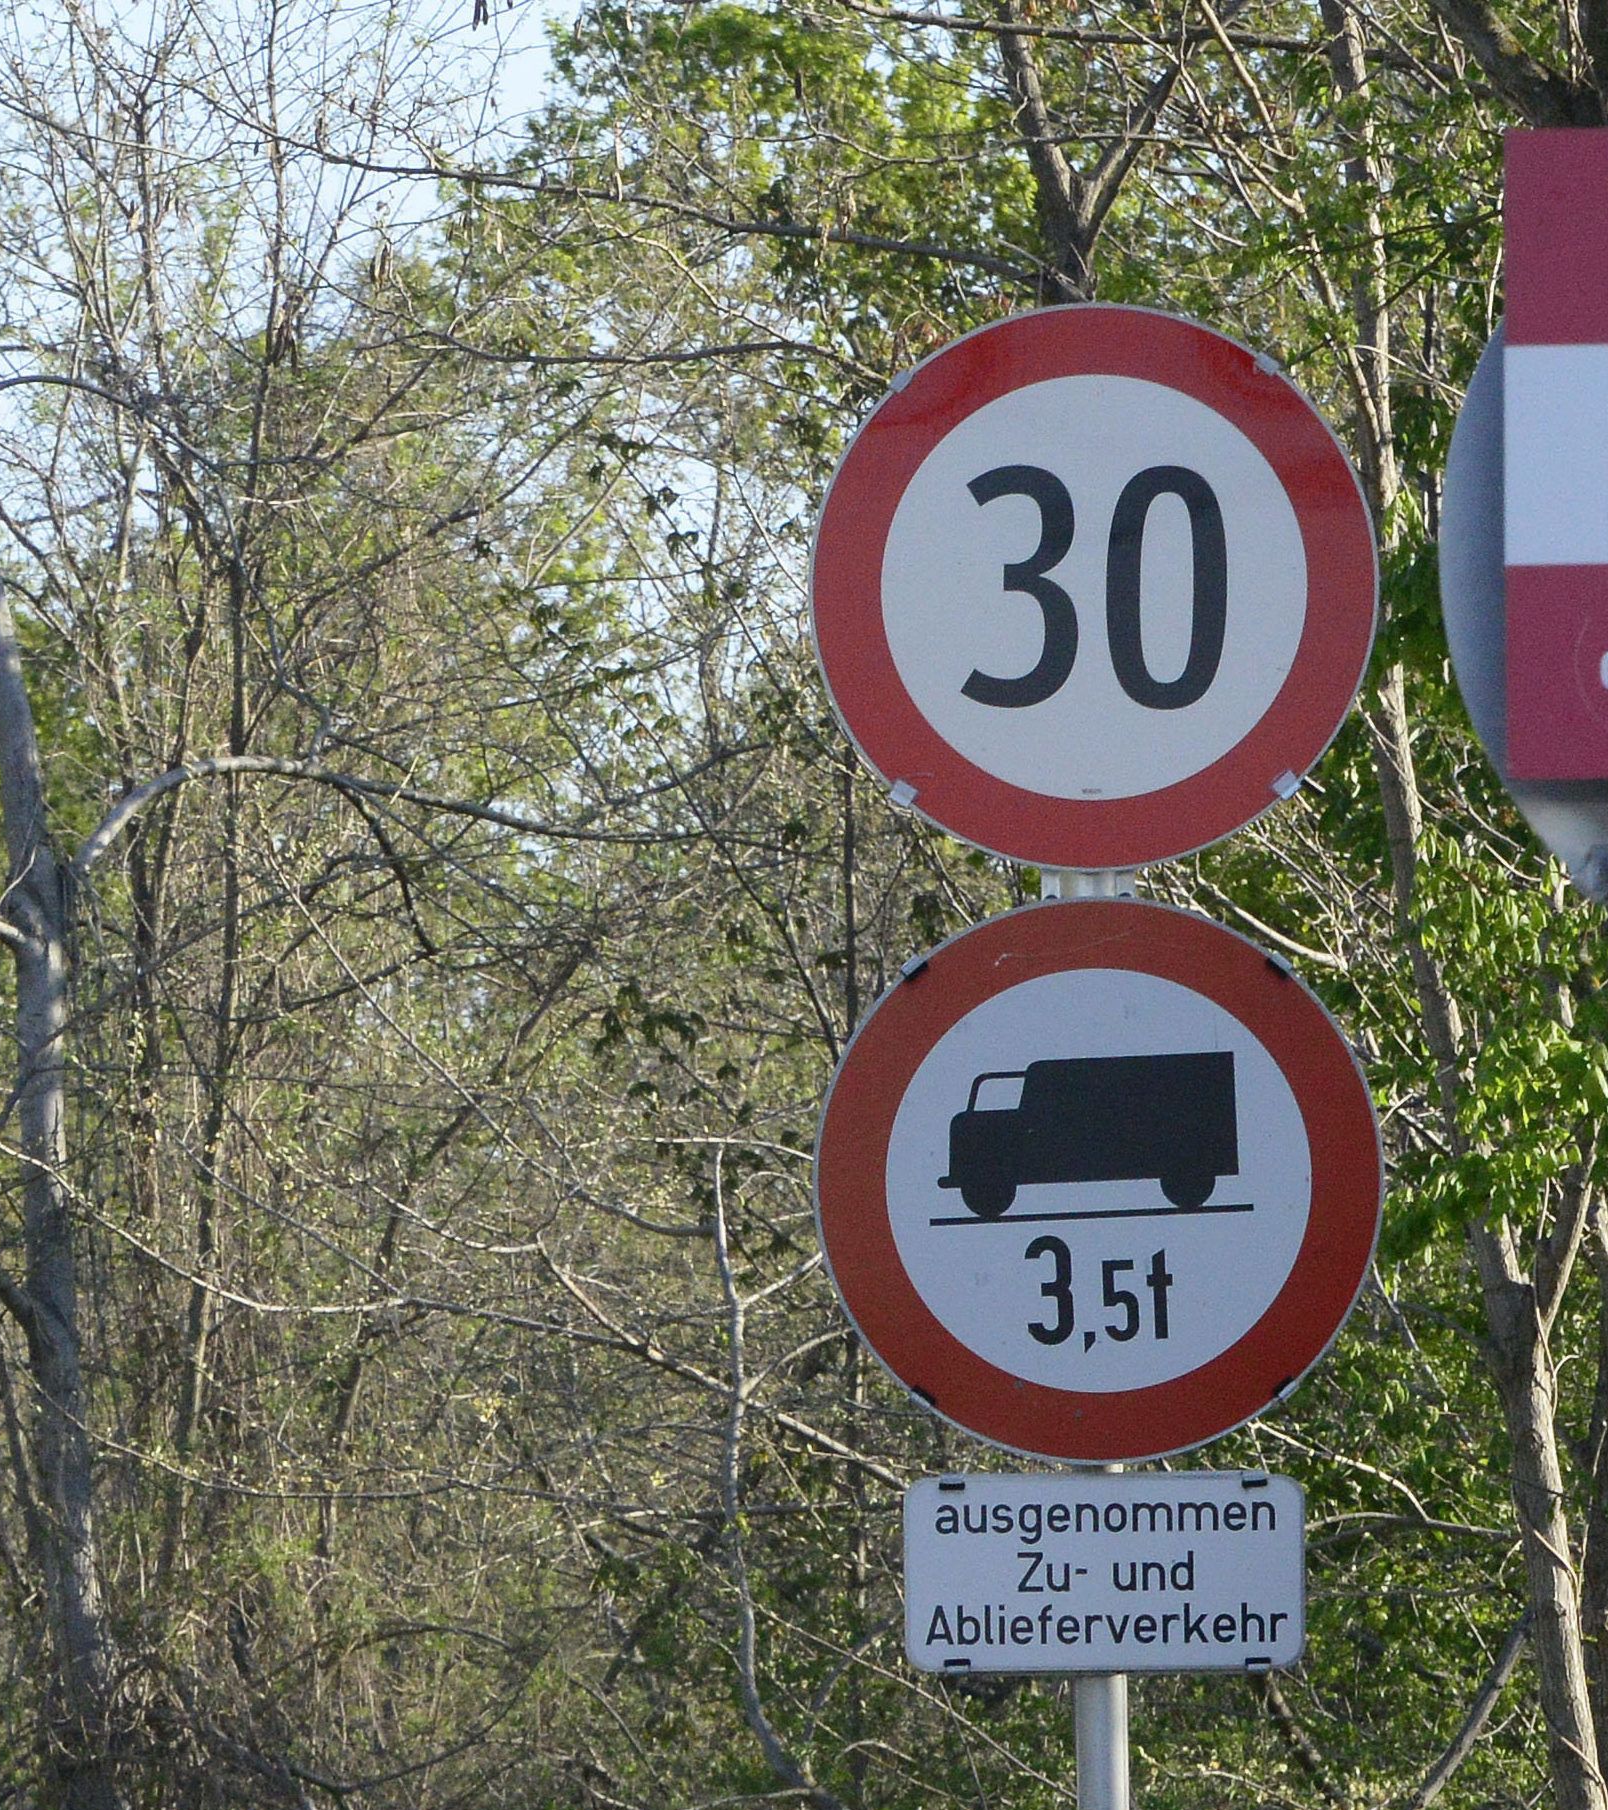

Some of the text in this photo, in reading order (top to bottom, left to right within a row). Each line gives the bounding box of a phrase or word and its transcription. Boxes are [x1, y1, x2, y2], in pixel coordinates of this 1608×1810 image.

[960, 463, 1228, 710] 30
[1024, 1236, 1173, 1352] 3,5t
[935, 1497, 1276, 1544] ausgenommen
[1016, 1550, 1195, 1593] Zu- und
[926, 1602, 1288, 1646] Ablieferverkehr
